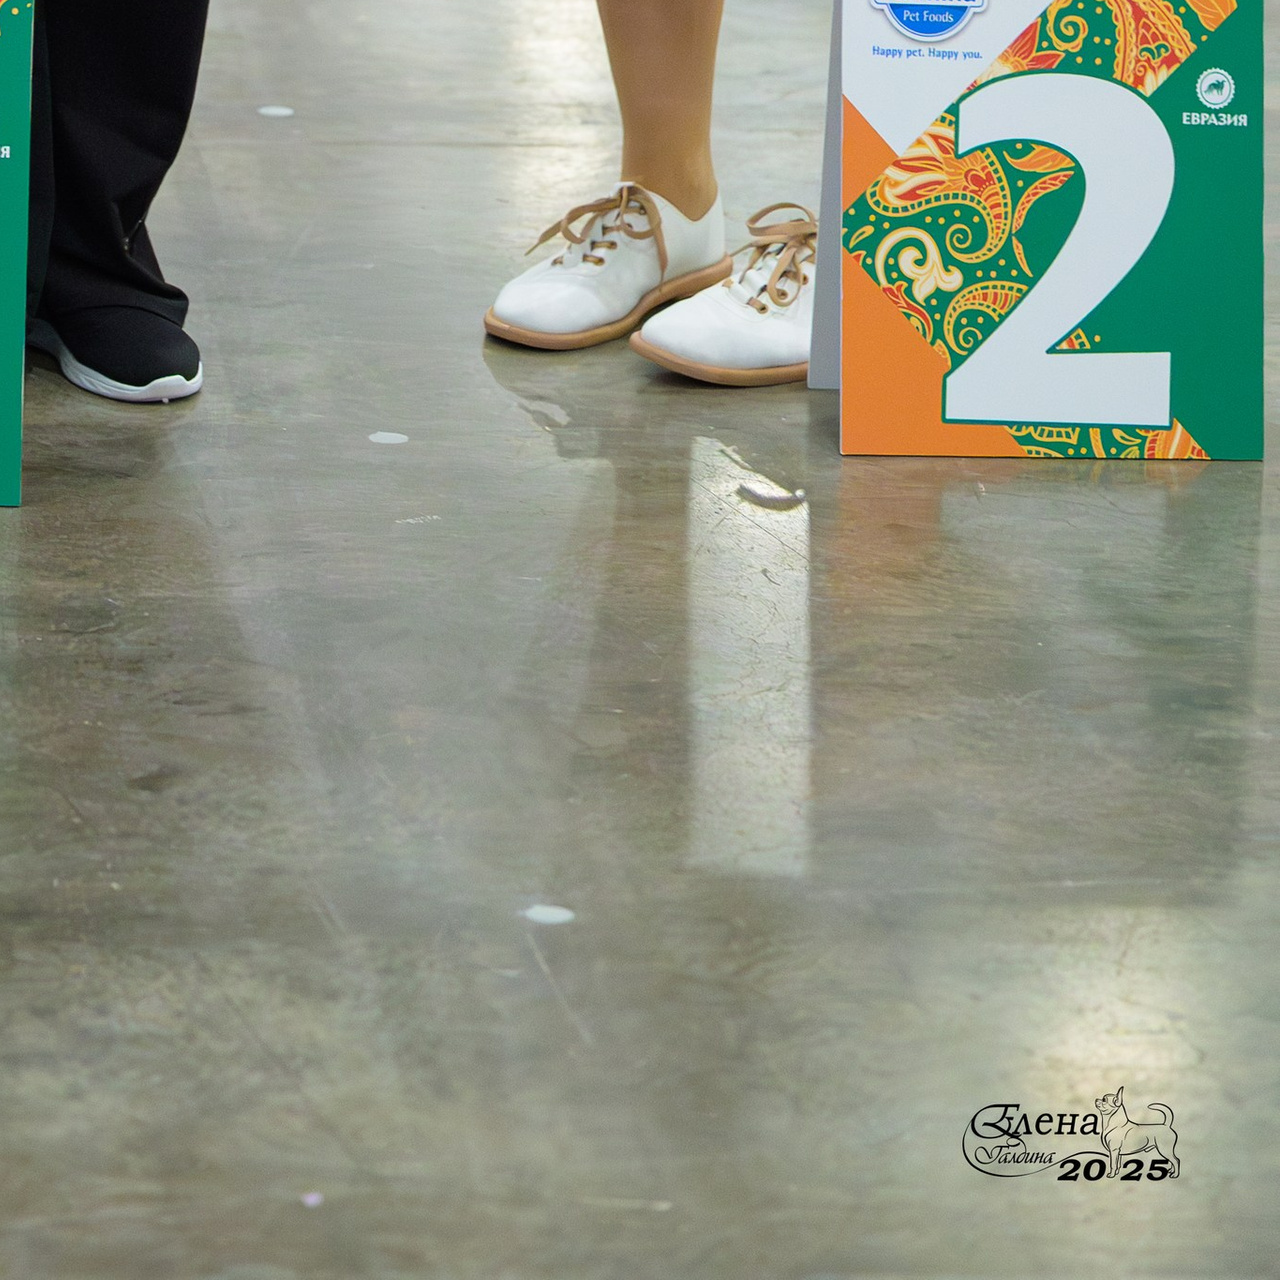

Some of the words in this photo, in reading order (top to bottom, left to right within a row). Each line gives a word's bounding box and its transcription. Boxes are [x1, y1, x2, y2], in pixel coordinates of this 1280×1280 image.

[903, 10, 920, 22] Pet
[923, 10, 954, 23] Foods
[872, 45, 903, 58] Happy
[906, 47, 925, 58] pet.
[928, 47, 959, 60] Happy
[962, 51, 983, 60] you.
[1182, 111, 1248, 127] ЕВРАЗИЯ
[945, 73, 1175, 426] 2
